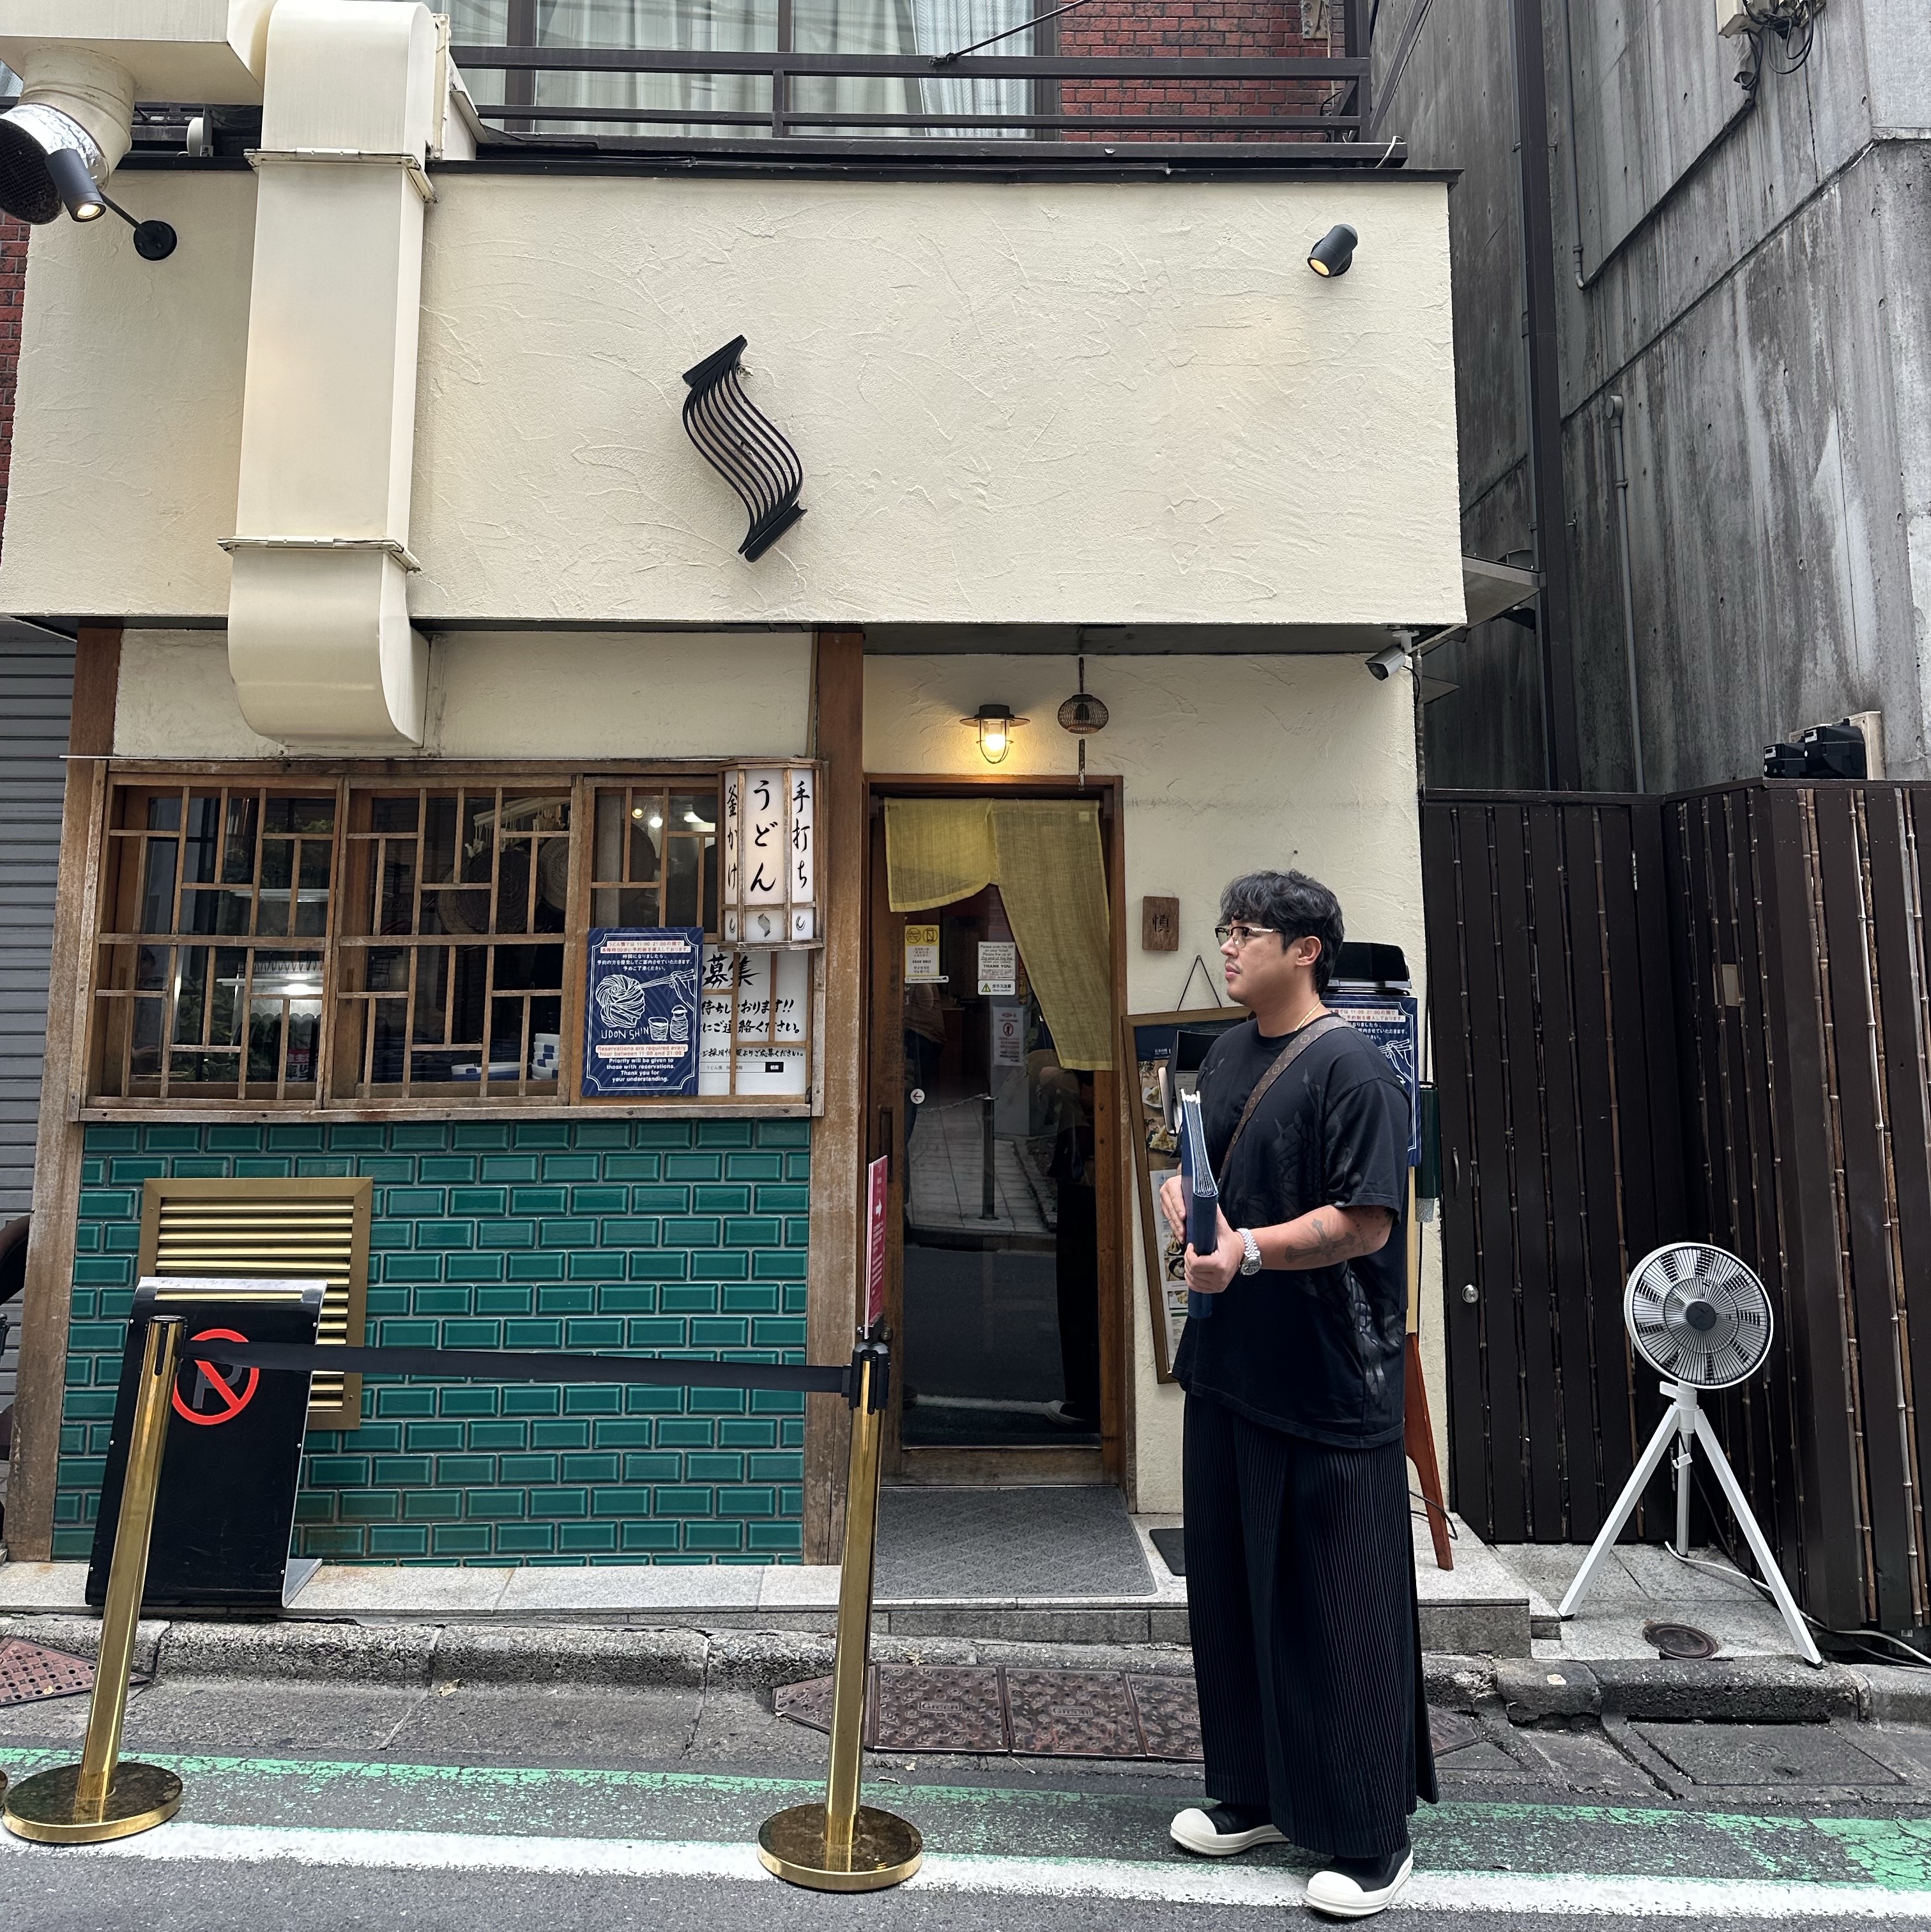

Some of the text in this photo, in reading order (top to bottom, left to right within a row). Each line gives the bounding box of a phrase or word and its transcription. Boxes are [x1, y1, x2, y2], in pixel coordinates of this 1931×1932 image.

[750, 780, 779, 892] うどん
[792, 781, 811, 889] 手打ち
[1152, 914, 1170, 932] 慎
[702, 999, 794, 1015] 待ちしおります!!
[601, 1026, 650, 1040] UDON SHIN
